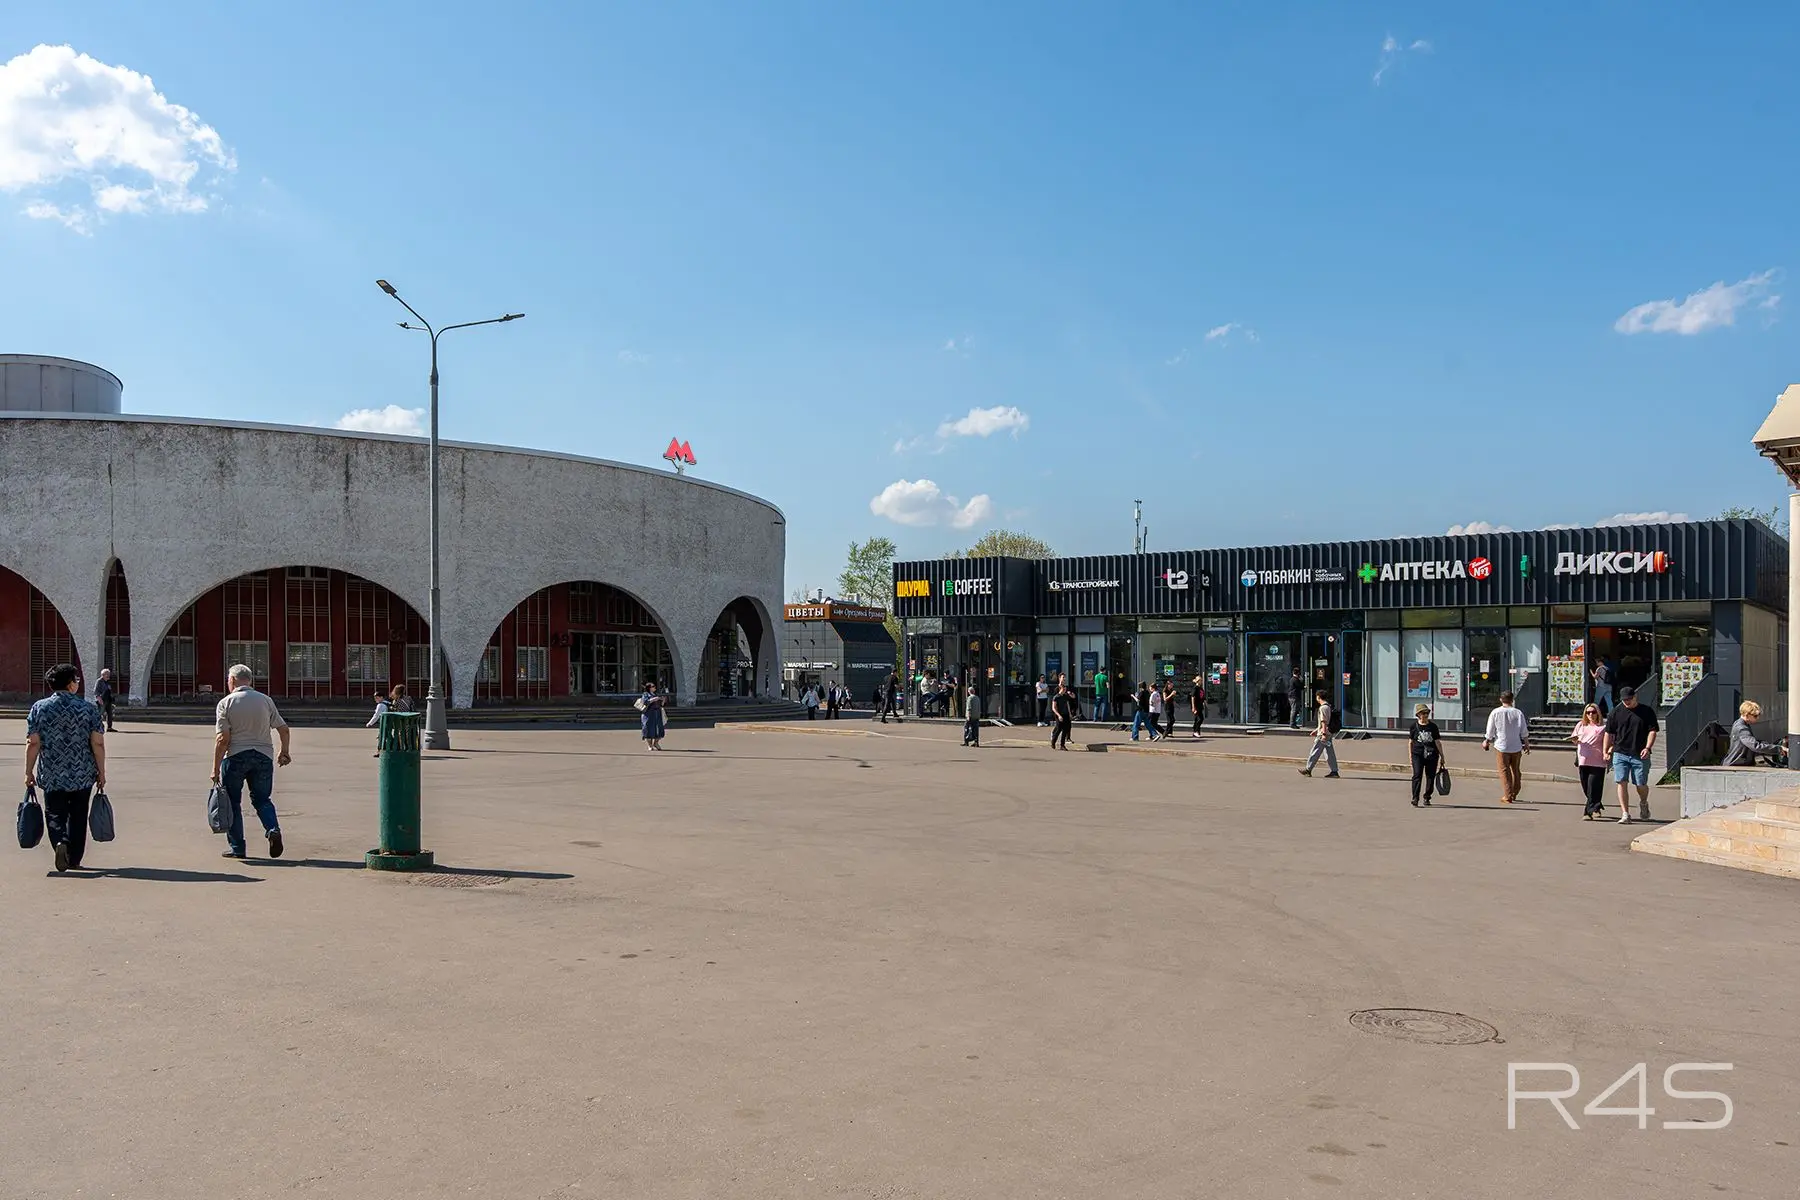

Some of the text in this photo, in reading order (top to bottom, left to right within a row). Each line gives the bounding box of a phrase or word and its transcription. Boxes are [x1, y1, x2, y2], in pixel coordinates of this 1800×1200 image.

[1380, 560, 1466, 581] АПТЕКА
[1554, 551, 1653, 575] ДИКСИ
[1062, 579, 1120, 589] ТРАНССТРОЙБАНК
[1166, 568, 1189, 590] t2
[1258, 568, 1311, 585] ТАБАКИН
[896, 580, 930, 597] ШАУРМА
[945, 580, 954, 596] CUP
[954, 578, 993, 595] COFFEE
[788, 607, 824, 618] ЦВЕТЫ
